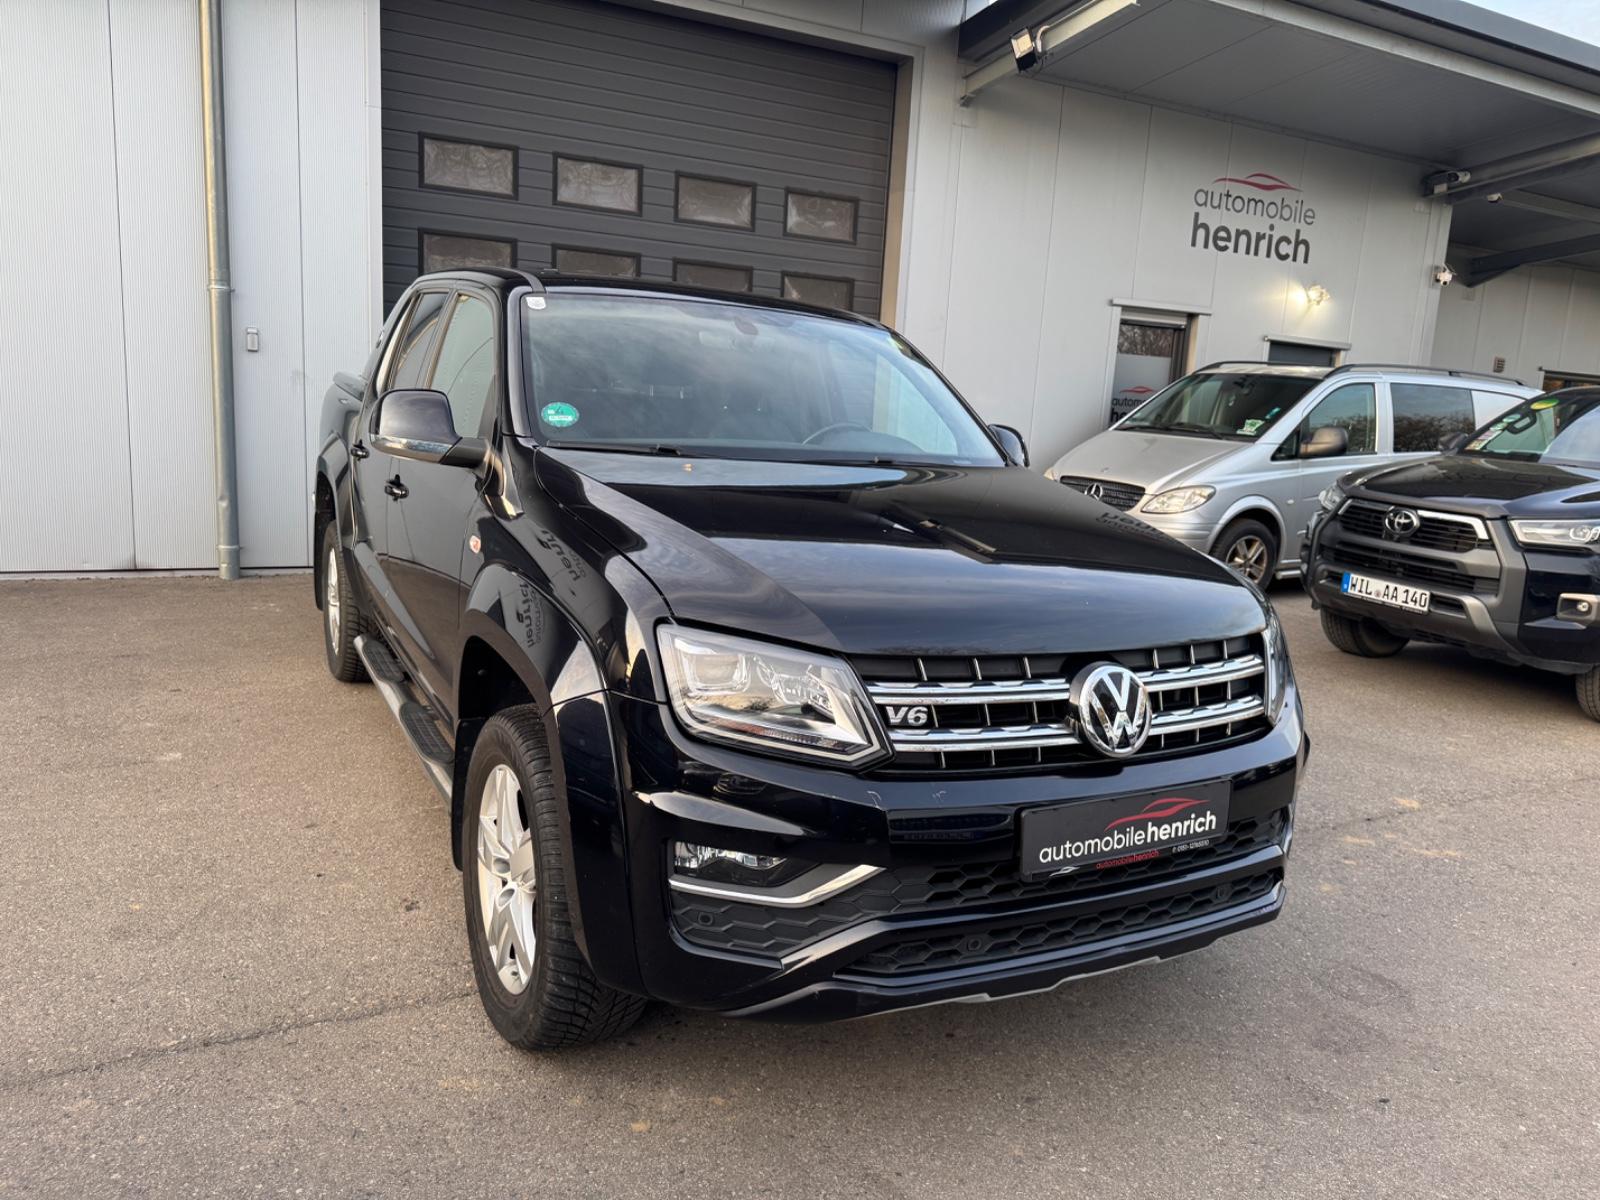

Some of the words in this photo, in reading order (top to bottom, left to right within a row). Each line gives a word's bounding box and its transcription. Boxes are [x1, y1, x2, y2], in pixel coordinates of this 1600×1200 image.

[1194, 188, 1316, 226] automobile
[1191, 212, 1311, 264] henrich
[1382, 584, 1399, 602] AA
[1402, 589, 1428, 608] 140
[885, 705, 929, 727] V6
